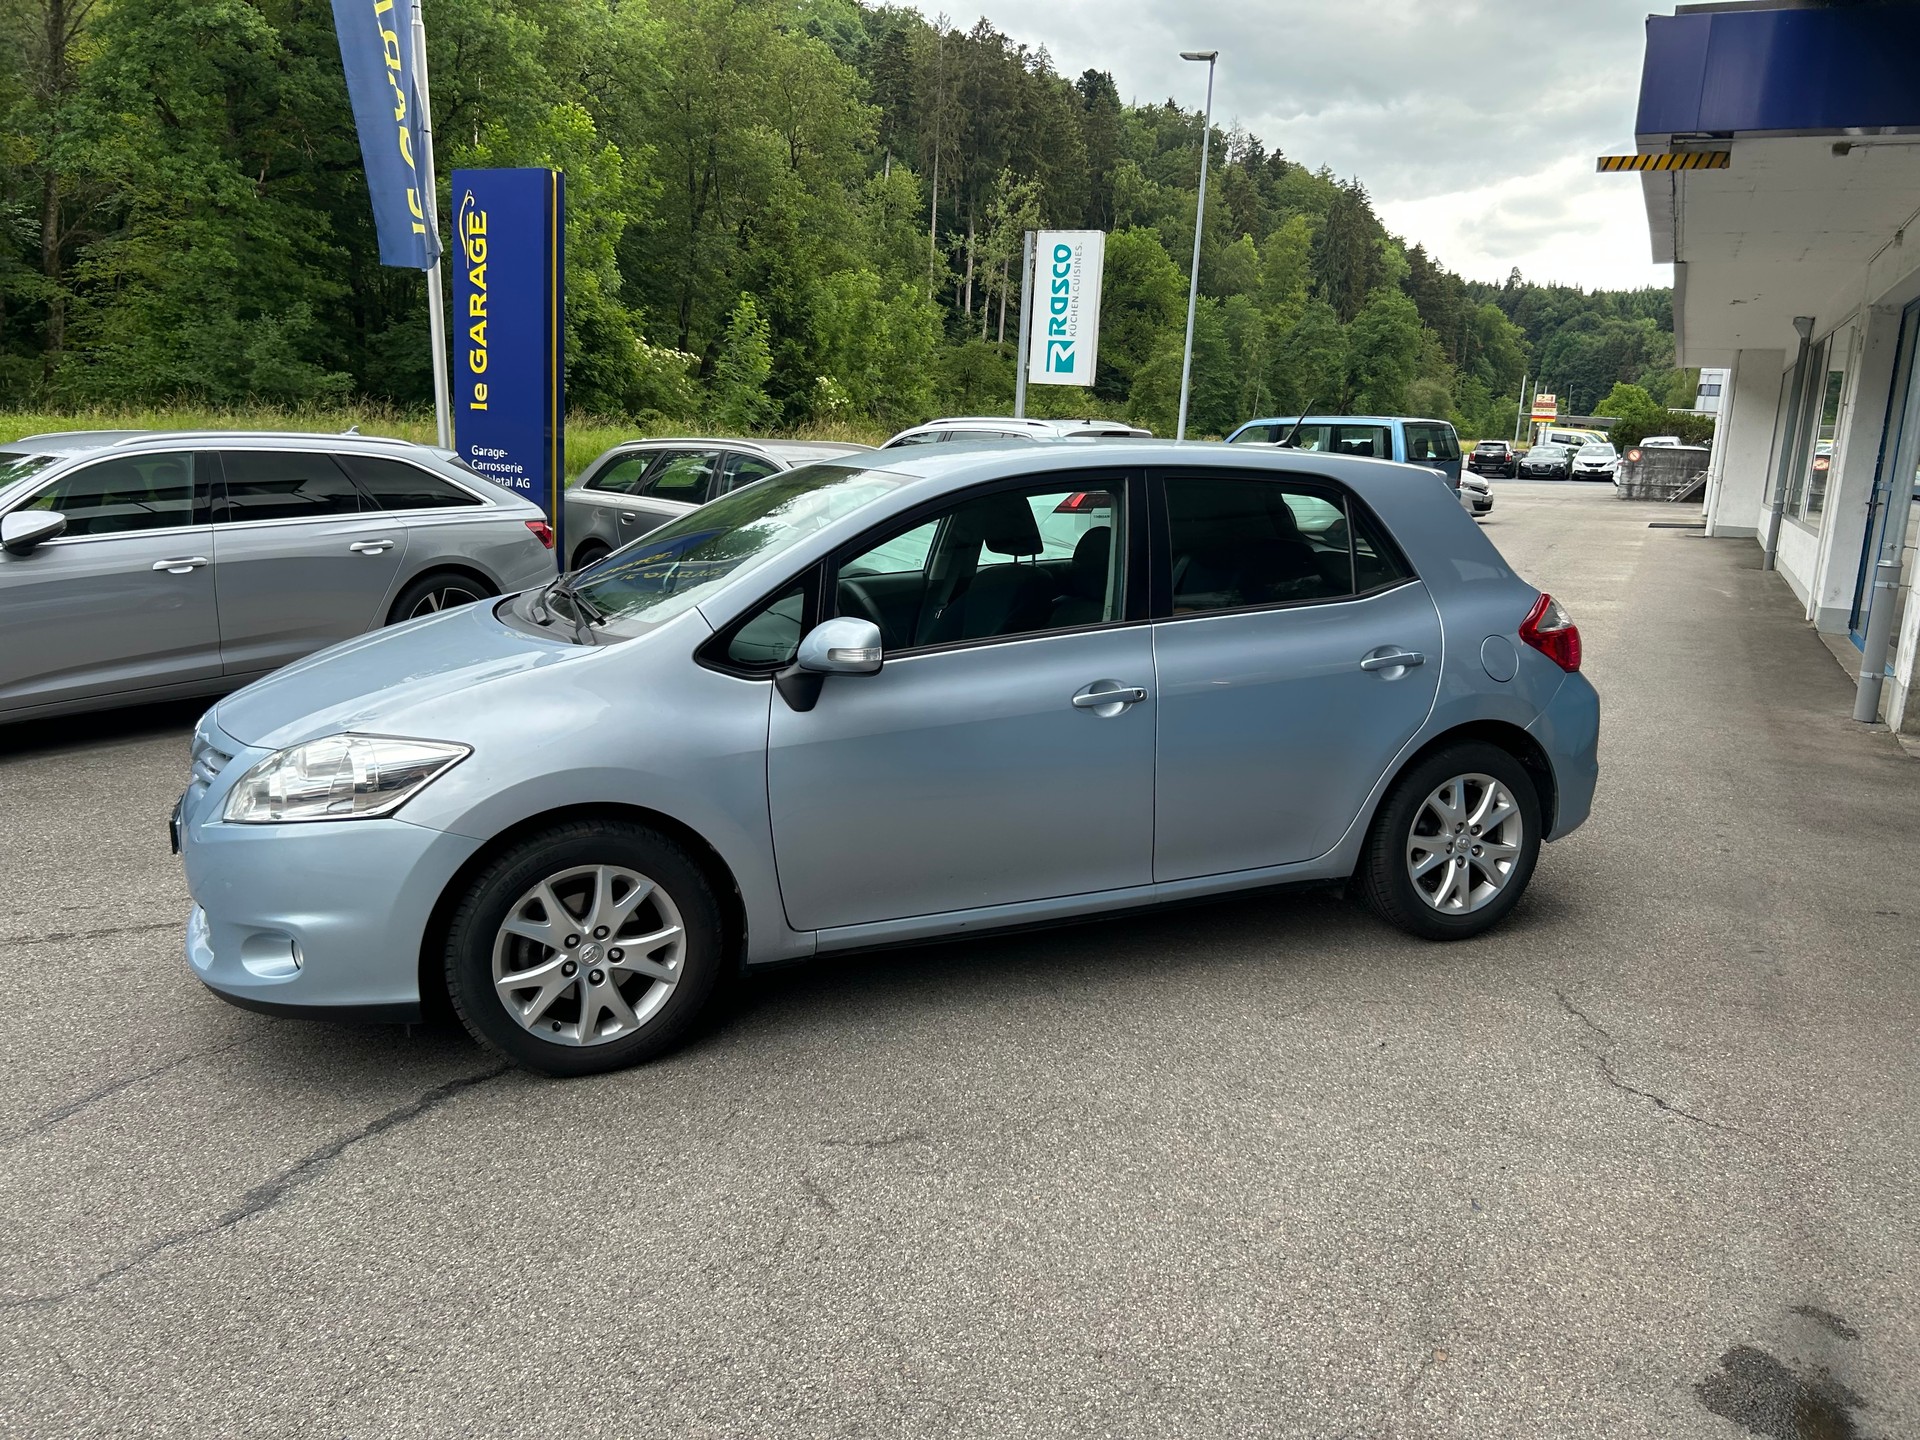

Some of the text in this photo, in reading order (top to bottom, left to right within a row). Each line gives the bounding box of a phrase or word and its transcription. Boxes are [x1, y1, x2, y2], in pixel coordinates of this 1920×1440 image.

[469, 210, 488, 411] le GARAGE
[471, 445, 508, 460] Garage-
[471, 459, 523, 474] Carrosserie
[515, 477, 531, 489] AG
